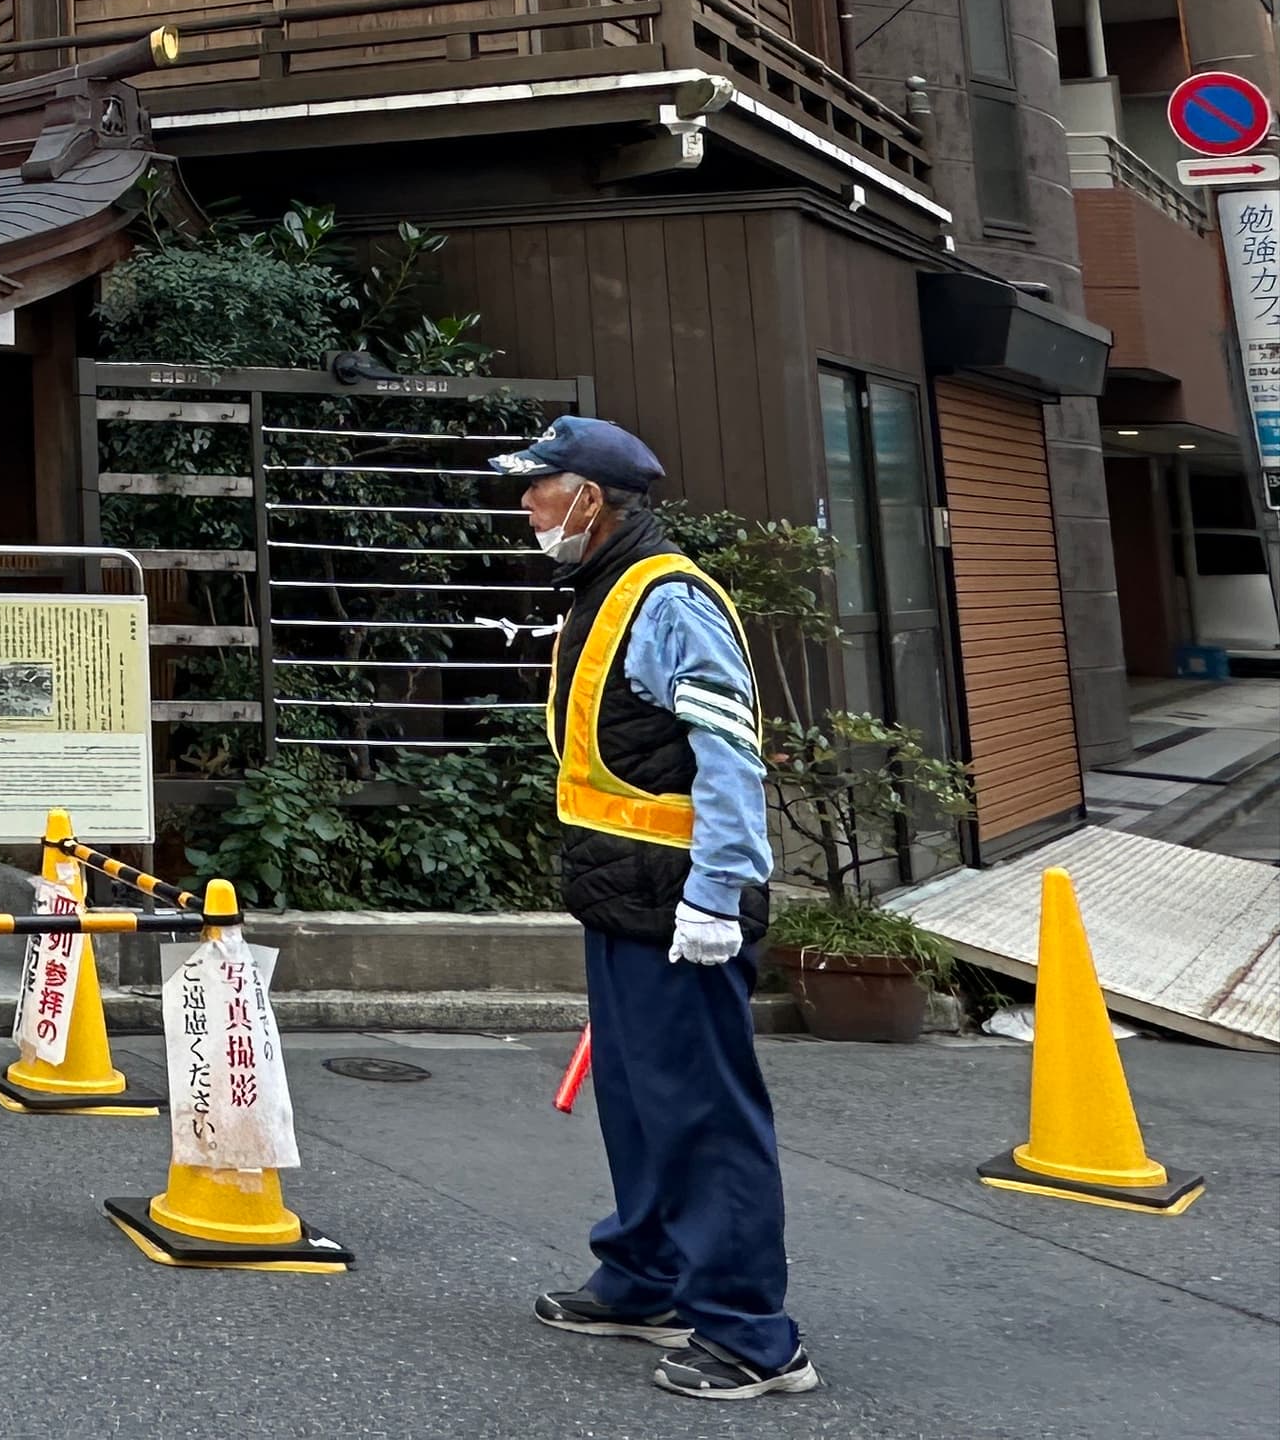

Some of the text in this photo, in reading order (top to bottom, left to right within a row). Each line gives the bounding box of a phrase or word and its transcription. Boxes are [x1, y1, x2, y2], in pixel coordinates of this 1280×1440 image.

[182, 959, 218, 1152] ご遠慮ください。
[219, 960, 259, 1109] 写真撮影
